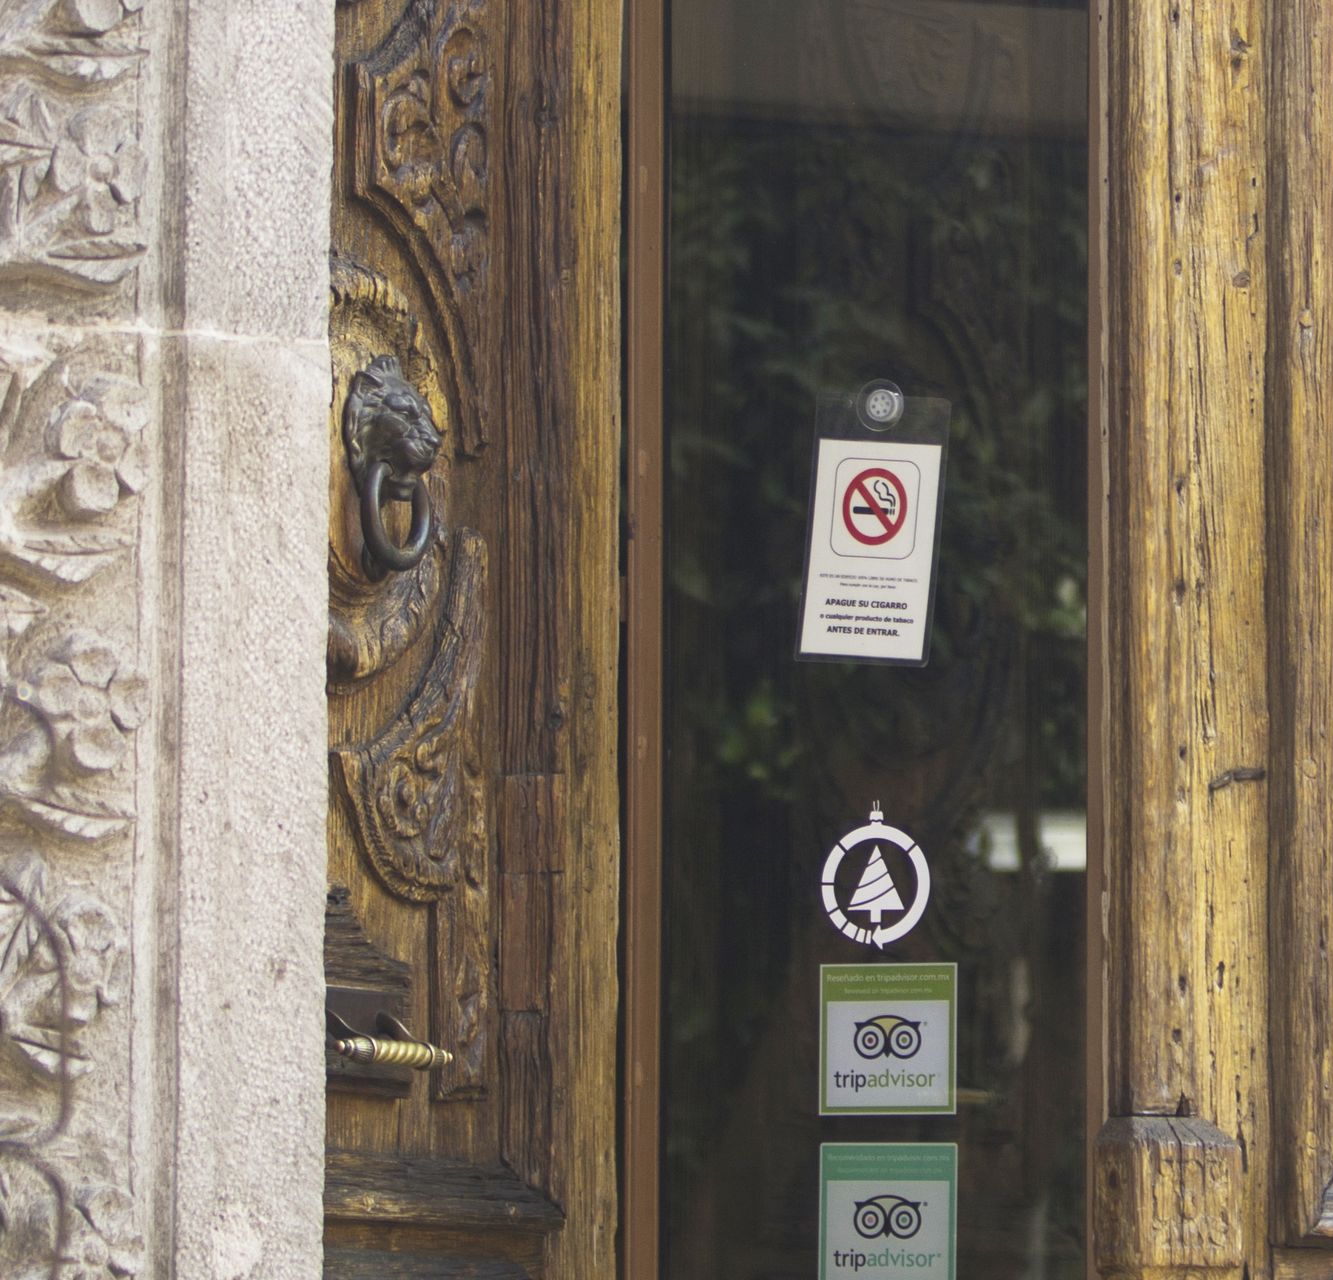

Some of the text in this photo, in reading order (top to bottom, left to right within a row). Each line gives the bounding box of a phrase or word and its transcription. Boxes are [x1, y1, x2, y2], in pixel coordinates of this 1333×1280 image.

[825, 598, 908, 610] APAGUE SU CIGARRO
[825, 613, 854, 622] cualquier
[855, 615, 883, 623] producto
[827, 626, 900, 637] ANTES DE ENTRAR.
[833, 1069, 936, 1093] tripadvisor
[833, 1248, 936, 1272] tripadvisor
